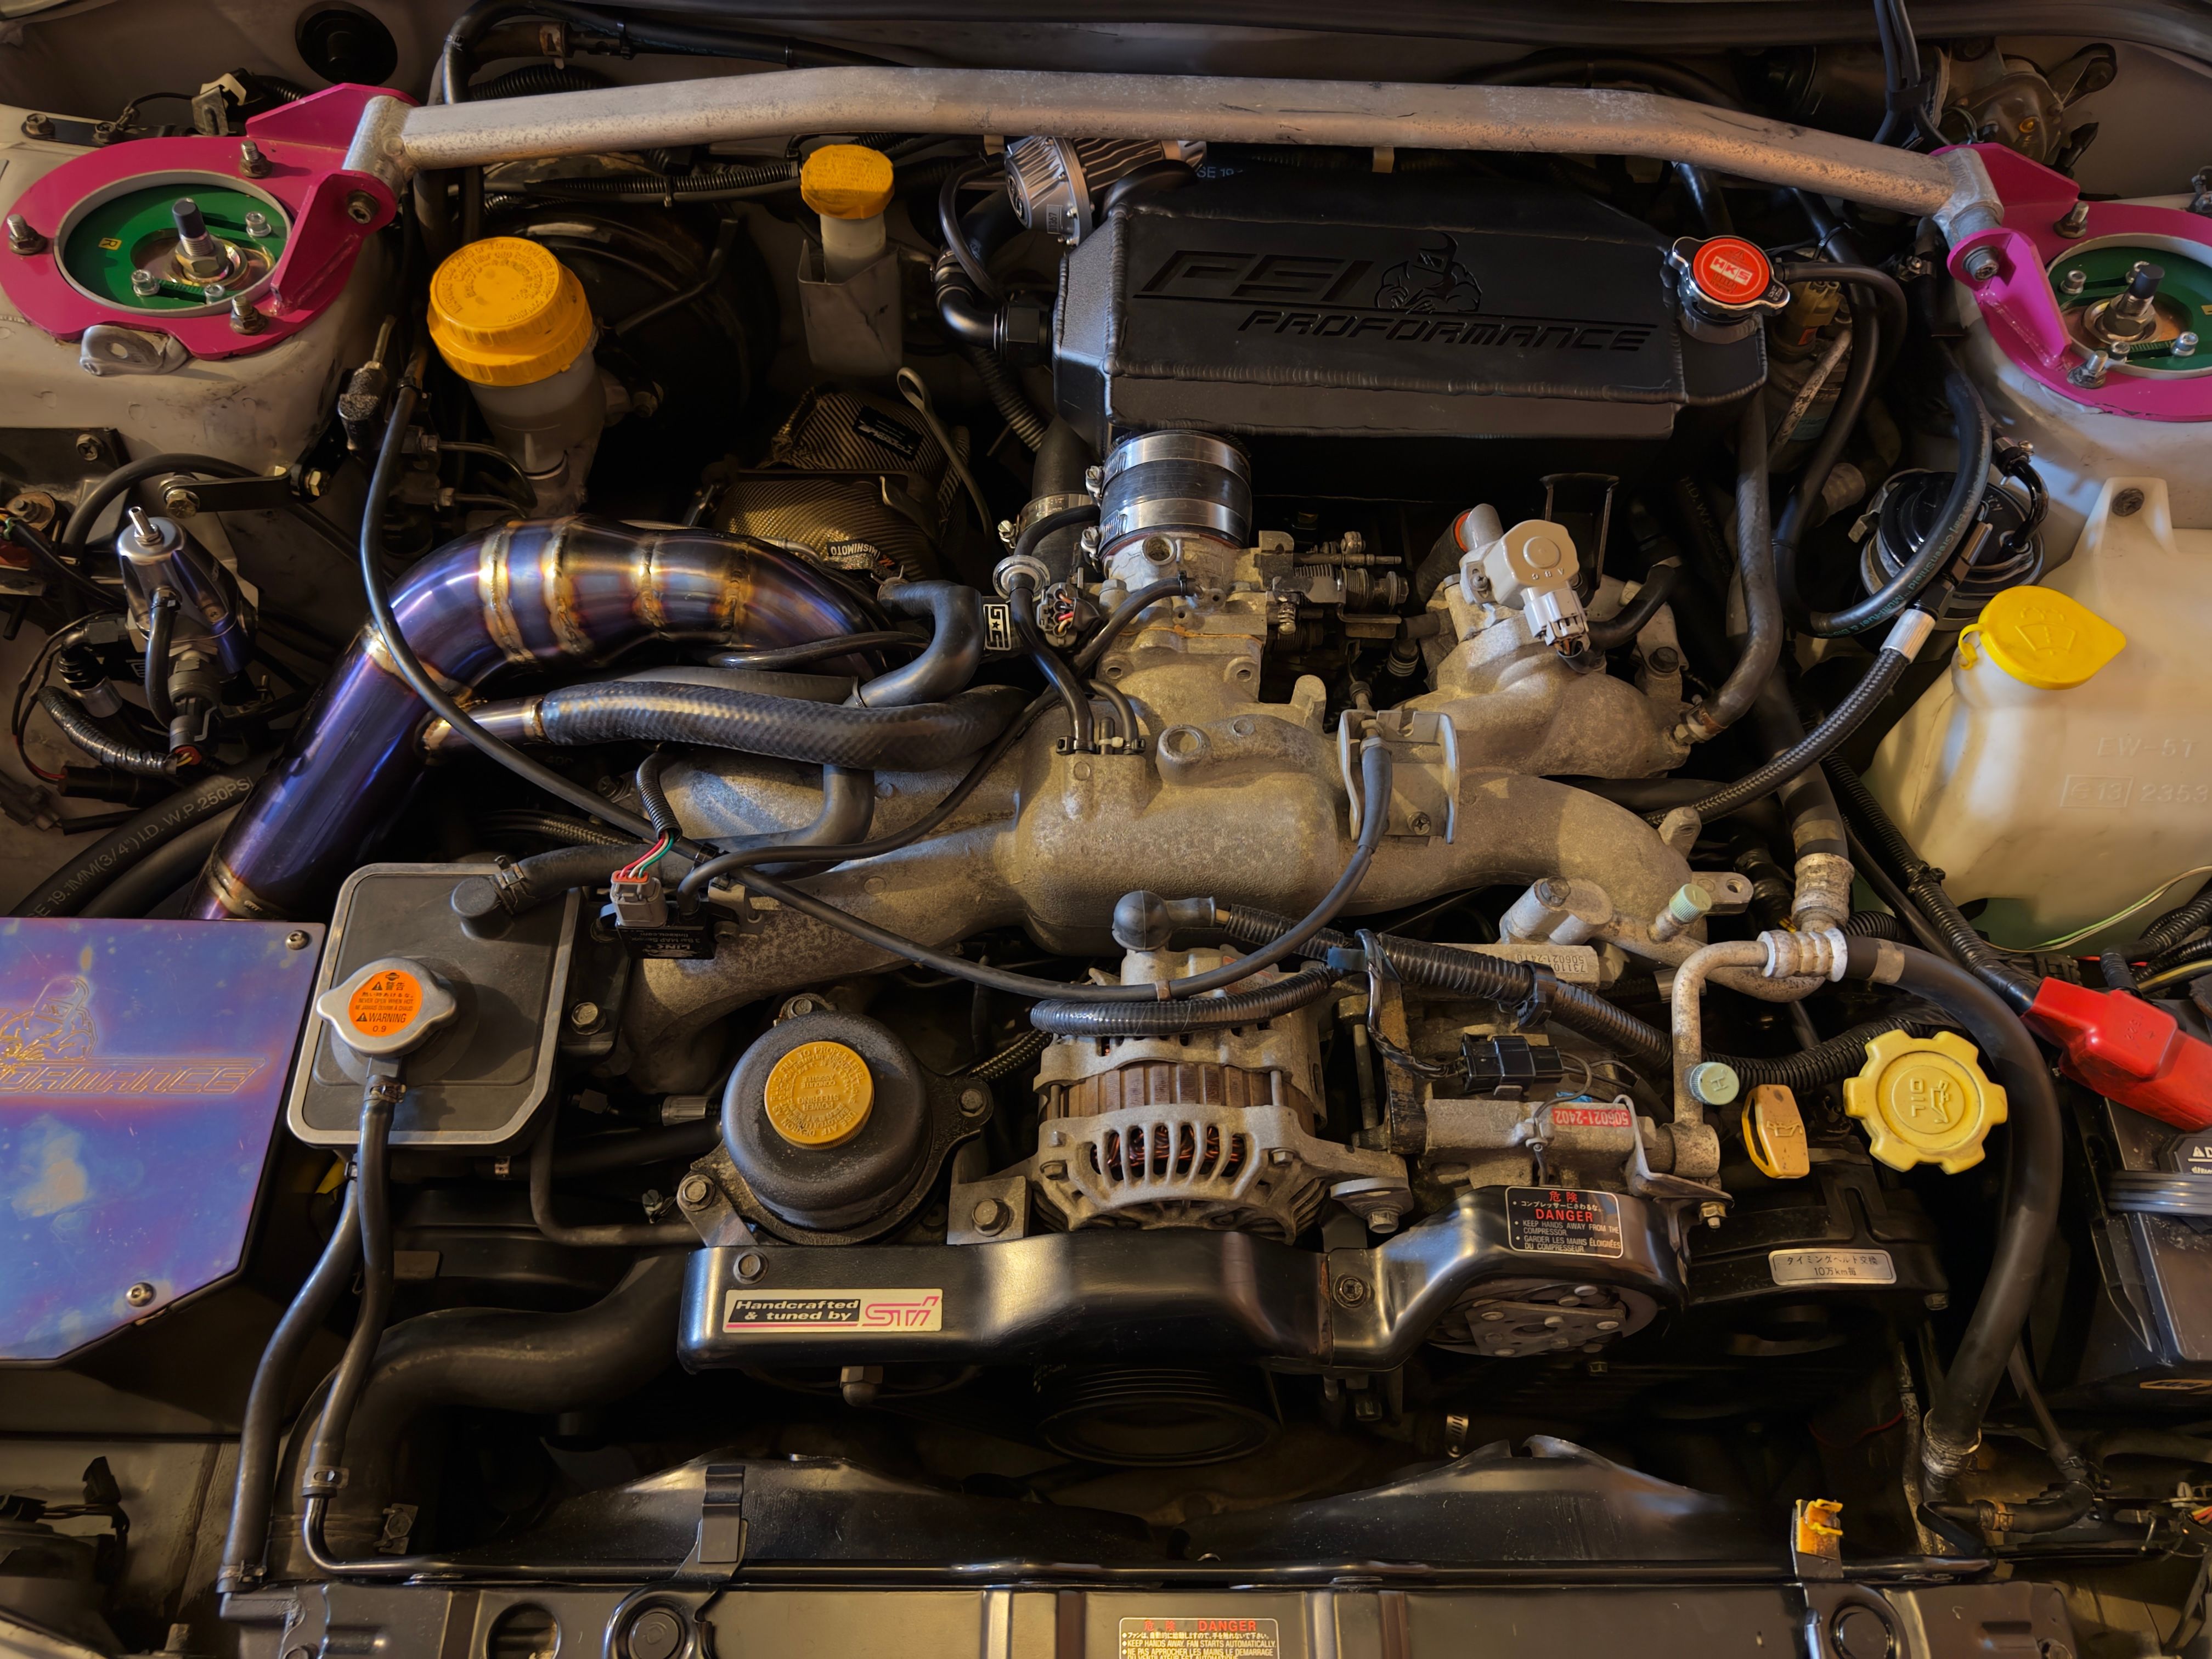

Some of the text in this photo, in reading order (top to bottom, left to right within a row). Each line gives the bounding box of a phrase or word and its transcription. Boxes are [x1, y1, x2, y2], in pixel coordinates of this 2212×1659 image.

[1712, 257, 1752, 282] HKS
[1237, 309, 1652, 352] PROFORMANCE
[831, 542, 878, 558] MISHIMOTO
[1517, 954, 1584, 964] 506021-2410
[369, 1012, 407, 1023] WARNING
[797, 1049, 811, 1059] TO
[814, 1046, 849, 1059] PROPER
[779, 1059, 795, 1074] FILL
[847, 1058, 865, 1085] LEVEL
[770, 1077, 781, 1102] FLUID
[1709, 1073, 1730, 1094] H
[797, 1094, 840, 1104] STEERING
[1910, 1077, 1925, 1118] OIL
[803, 1102, 834, 1111] POWER
[840, 1110, 856, 1127] USE
[1555, 1110, 1628, 1125] 506021-2402
[781, 1118, 816, 1137] DEXRON
[821, 1125, 839, 1136] ATF
[1549, 1190, 1578, 1203] 危険
[1536, 1209, 1593, 1222] DANGER
[1522, 1220, 1620, 1234] KEEP HANDS AWAY FROM THE
[1523, 1227, 1568, 1237] COMPRESSOR.
[1523, 1235, 1621, 1249] GARDER LES MAINS ÉLOIGNÉES
[1537, 1243, 1586, 1253] COMPRESSEUR.
[1814, 1266, 1857, 1277] 10万km毎
[736, 1300, 859, 1310] Handcrafted
[744, 1311, 852, 1322] & tuned by
[1198, 1620, 1257, 1632] DANGER
